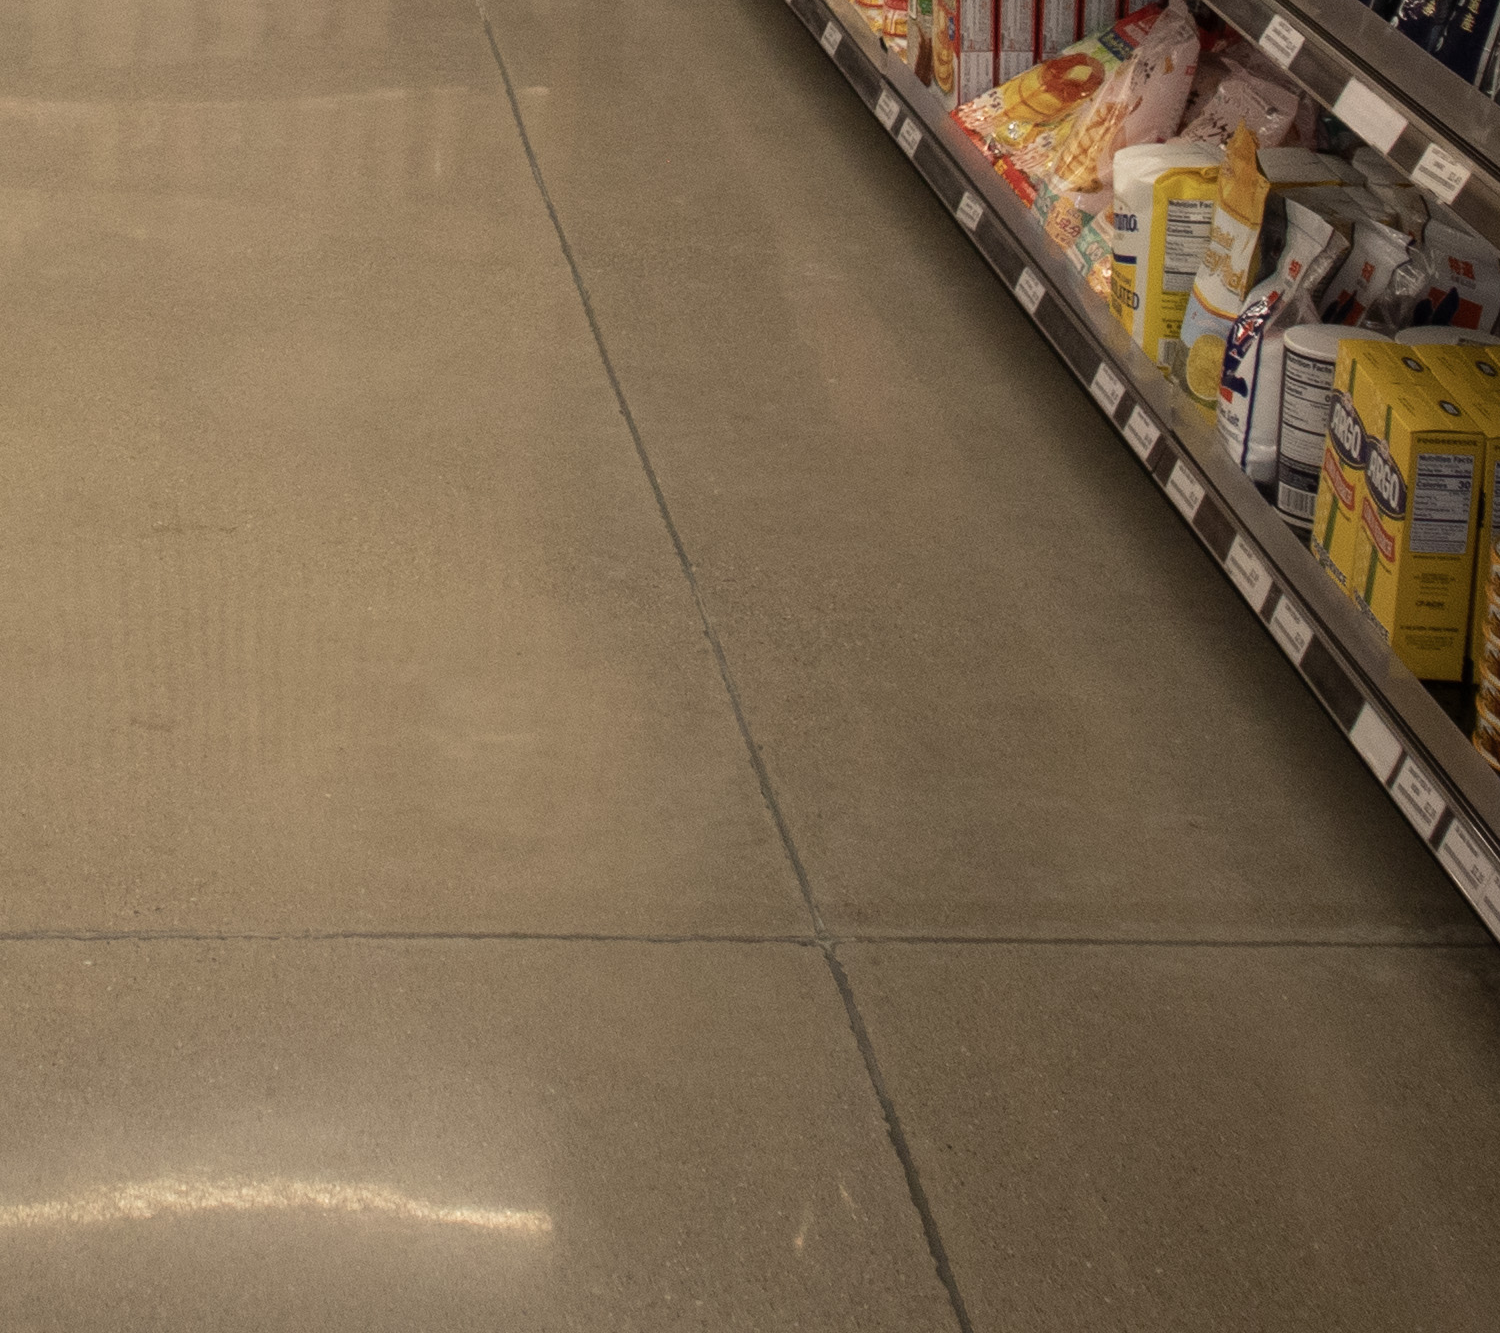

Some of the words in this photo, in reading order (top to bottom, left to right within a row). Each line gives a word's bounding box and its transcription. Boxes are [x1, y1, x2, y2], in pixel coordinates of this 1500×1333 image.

[1330, 398, 1364, 461] ARGO
[1418, 455, 1449, 464] Nutrition
[1452, 456, 1474, 465] Facts
[1367, 449, 1401, 512] ARGO
